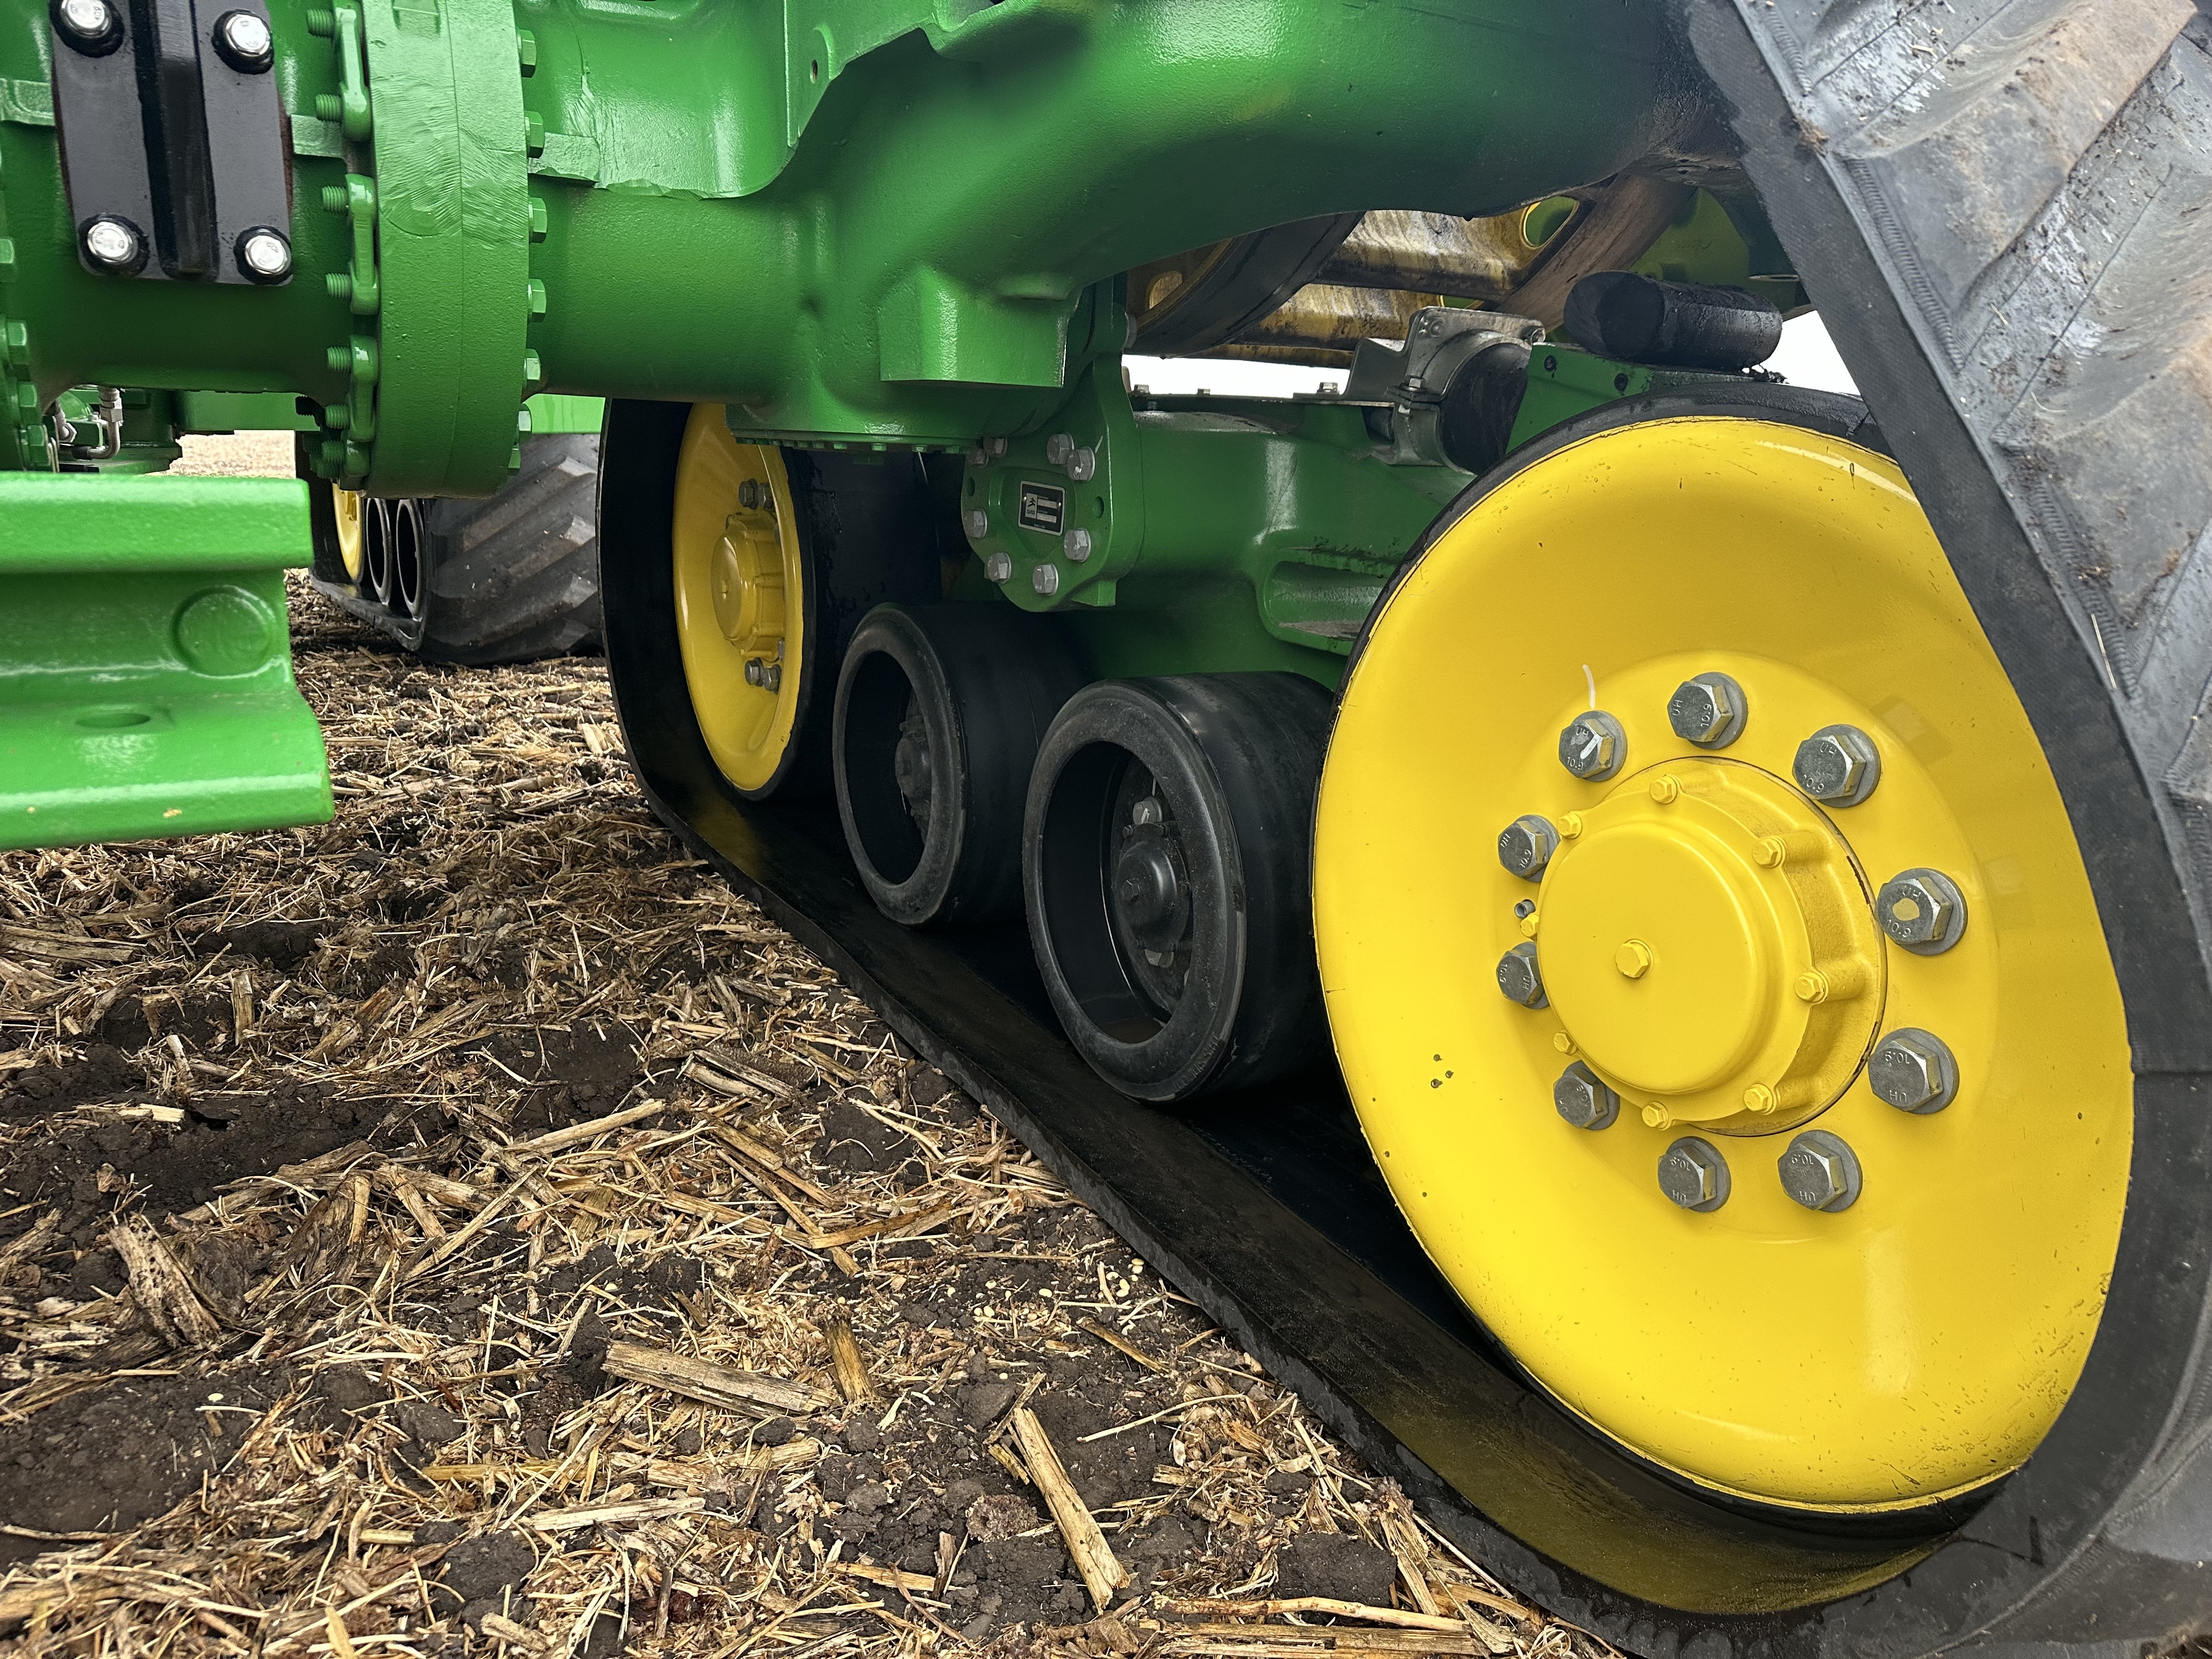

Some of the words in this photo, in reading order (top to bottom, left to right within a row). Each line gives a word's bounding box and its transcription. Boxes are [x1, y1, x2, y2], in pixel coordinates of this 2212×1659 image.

[1672, 699, 1683, 716] UH
[1700, 703, 1712, 727] 10.9
[1819, 742, 1837, 758] UH
[1567, 757, 1584, 770] 10.9
[1802, 774, 1825, 793] 10.9
[1500, 833, 1511, 848] UH
[1519, 849, 1532, 868] 10.9
[1902, 885, 1921, 900] UH
[1887, 919, 1911, 938] 10.9
[1499, 963, 1508, 983] 10.9
[1522, 975, 1531, 990] UH
[1885, 1051, 1910, 1065] 10.9
[1889, 1090, 1907, 1103] UH
[1669, 1156, 1691, 1171] 10.9
[1791, 1154, 1814, 1165] 10.9
[1672, 1189, 1686, 1203] UH
[1799, 1190, 1816, 1202] UH
